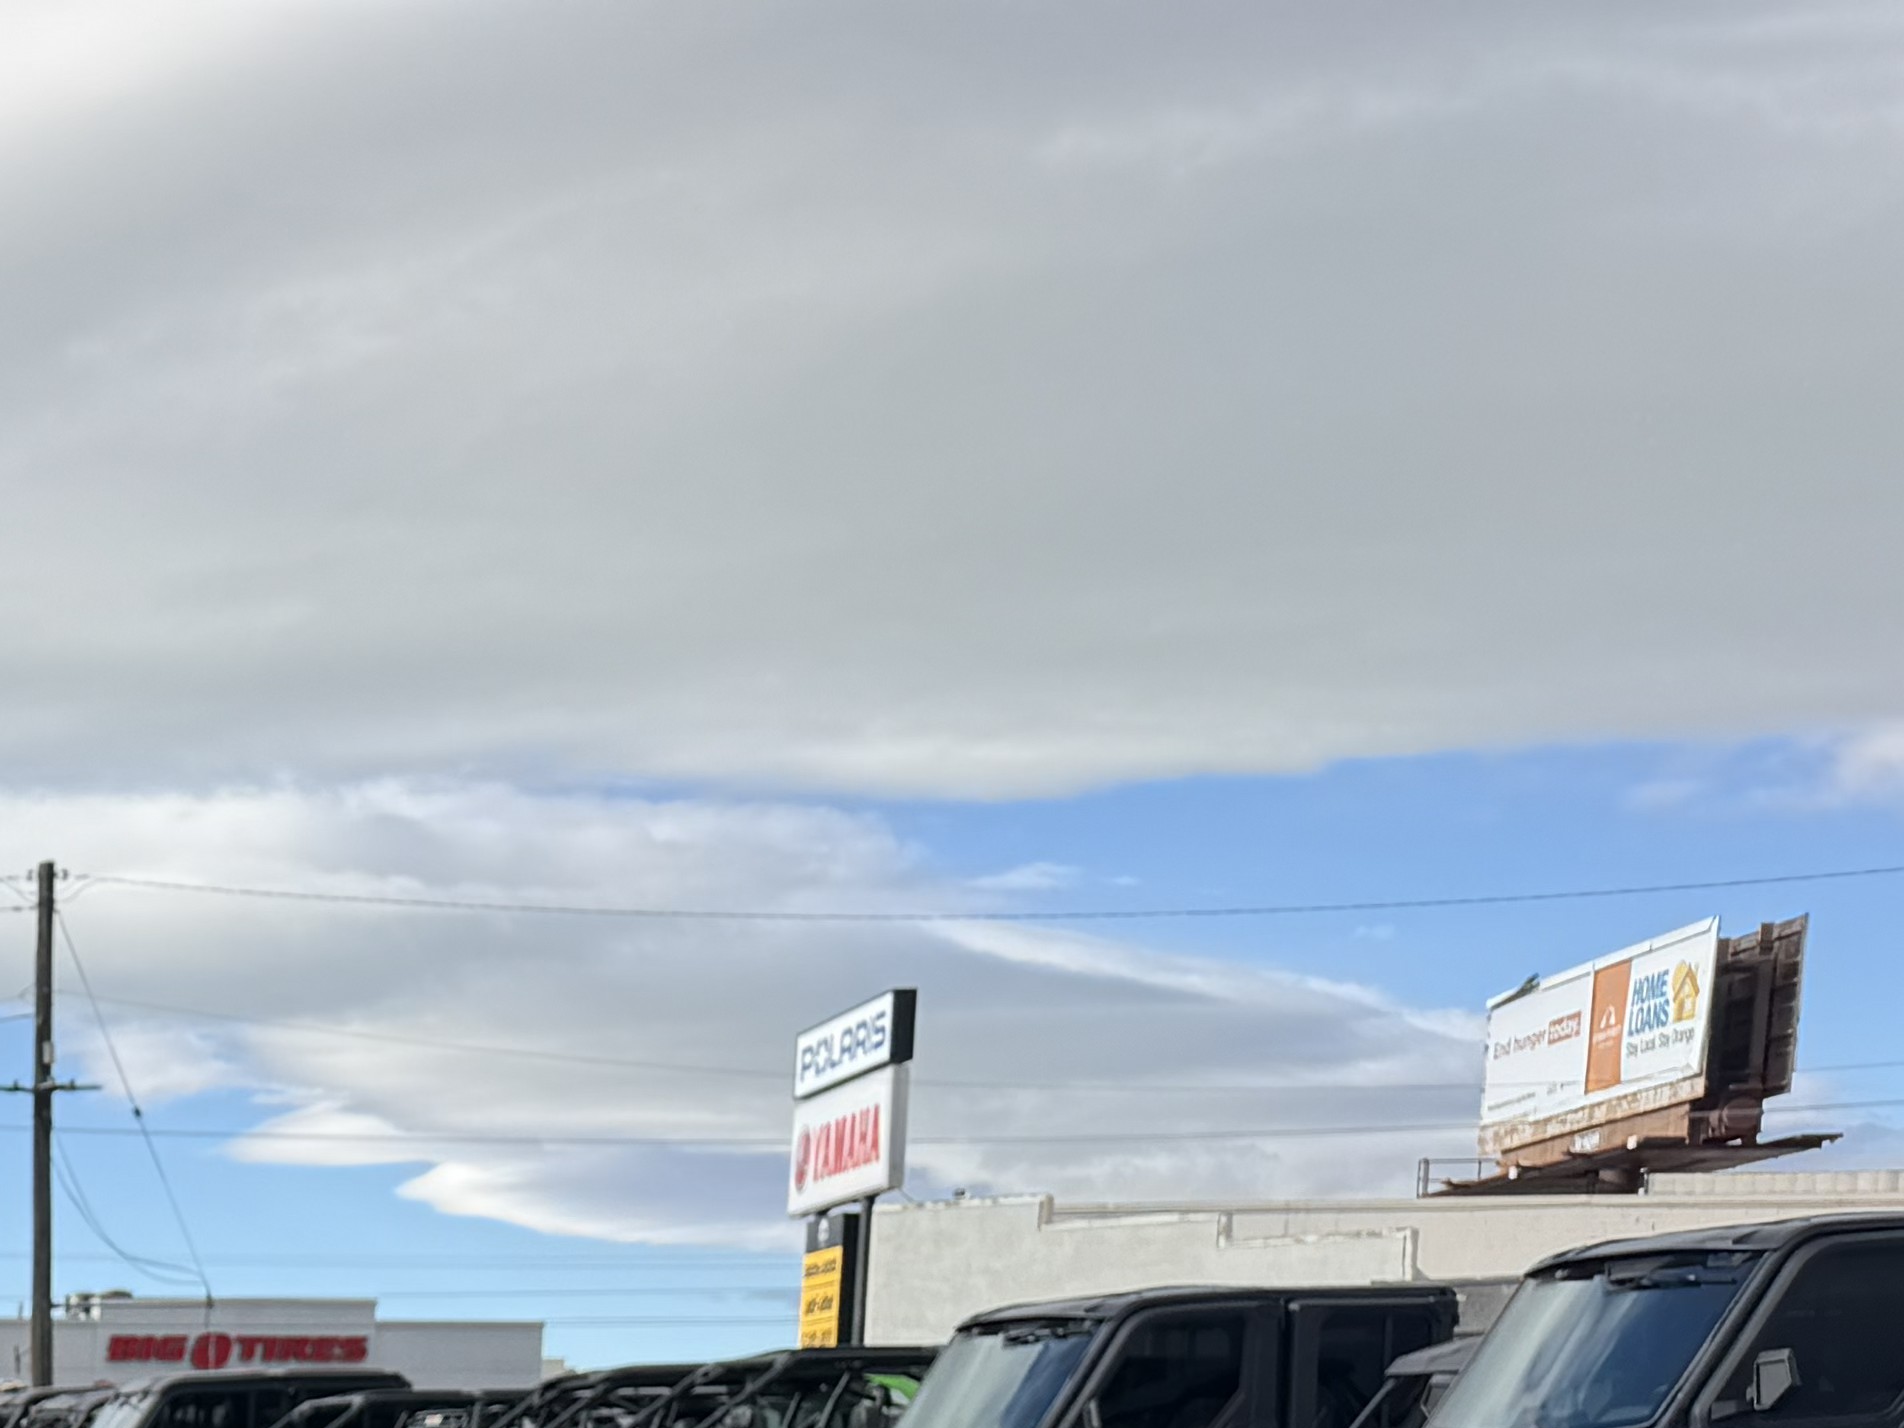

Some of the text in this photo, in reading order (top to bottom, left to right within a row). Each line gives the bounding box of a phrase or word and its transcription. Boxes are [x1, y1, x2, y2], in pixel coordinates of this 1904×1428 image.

[1631, 968, 1670, 1007] HOME
[1627, 999, 1670, 1037] LOANS
[799, 1010, 887, 1083] POLARIS
[812, 1103, 880, 1183] YAMAHA
[106, 1334, 188, 1362] BIG
[234, 1335, 369, 1363] TIRES
